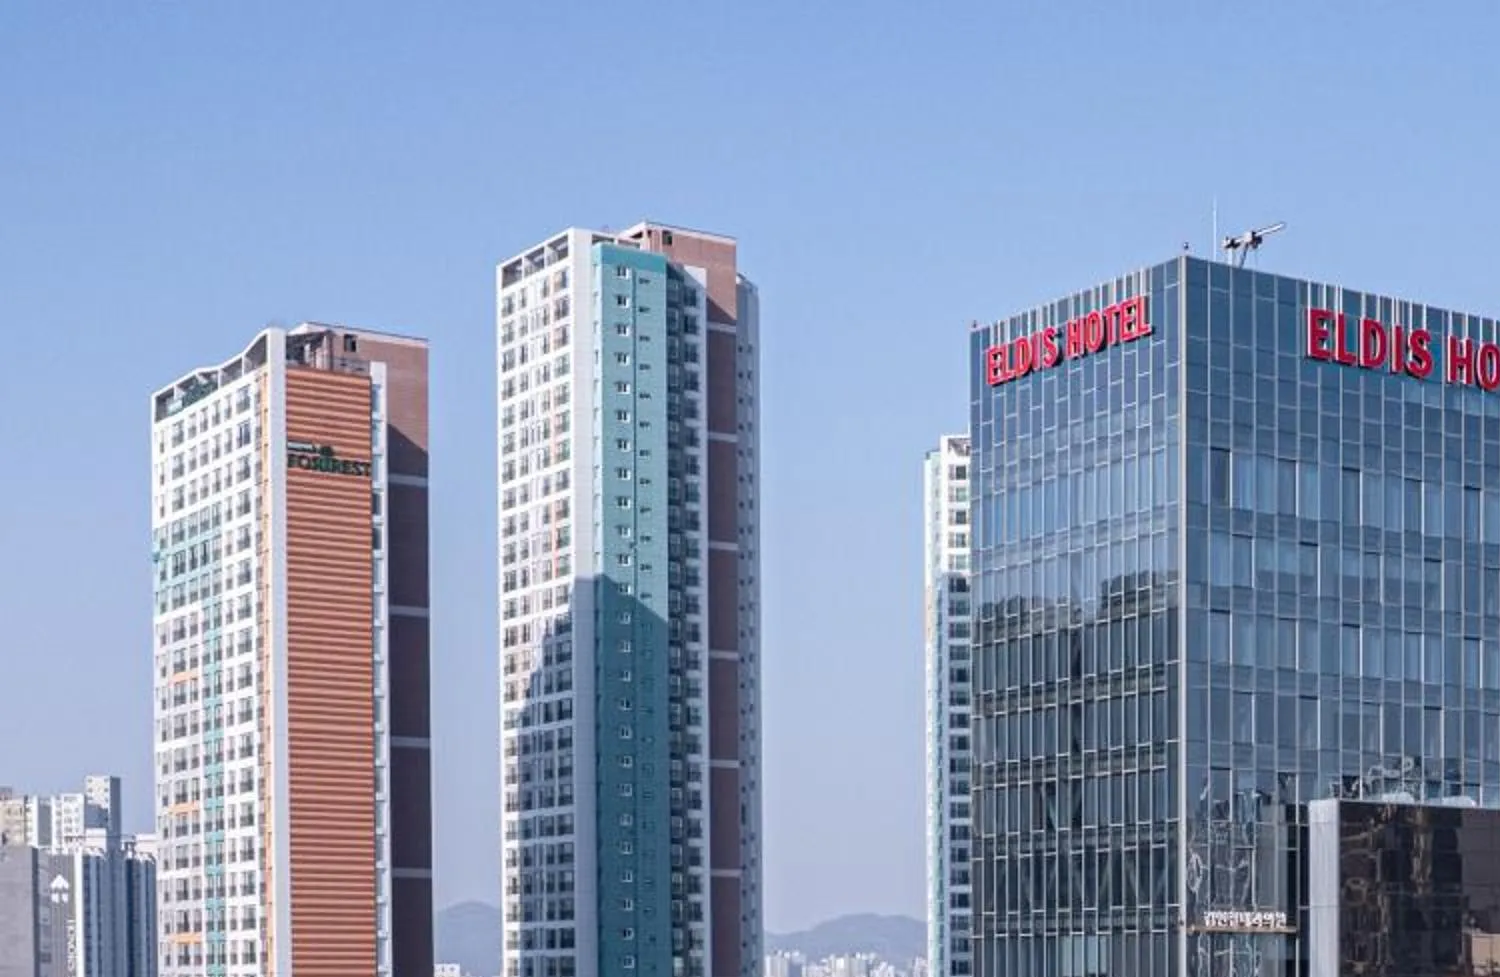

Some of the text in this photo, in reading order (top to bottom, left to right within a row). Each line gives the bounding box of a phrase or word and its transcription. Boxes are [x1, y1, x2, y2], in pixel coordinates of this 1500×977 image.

[986, 296, 1152, 385] ELDIS HOTEL
[1307, 308, 1433, 379] ELDIS
